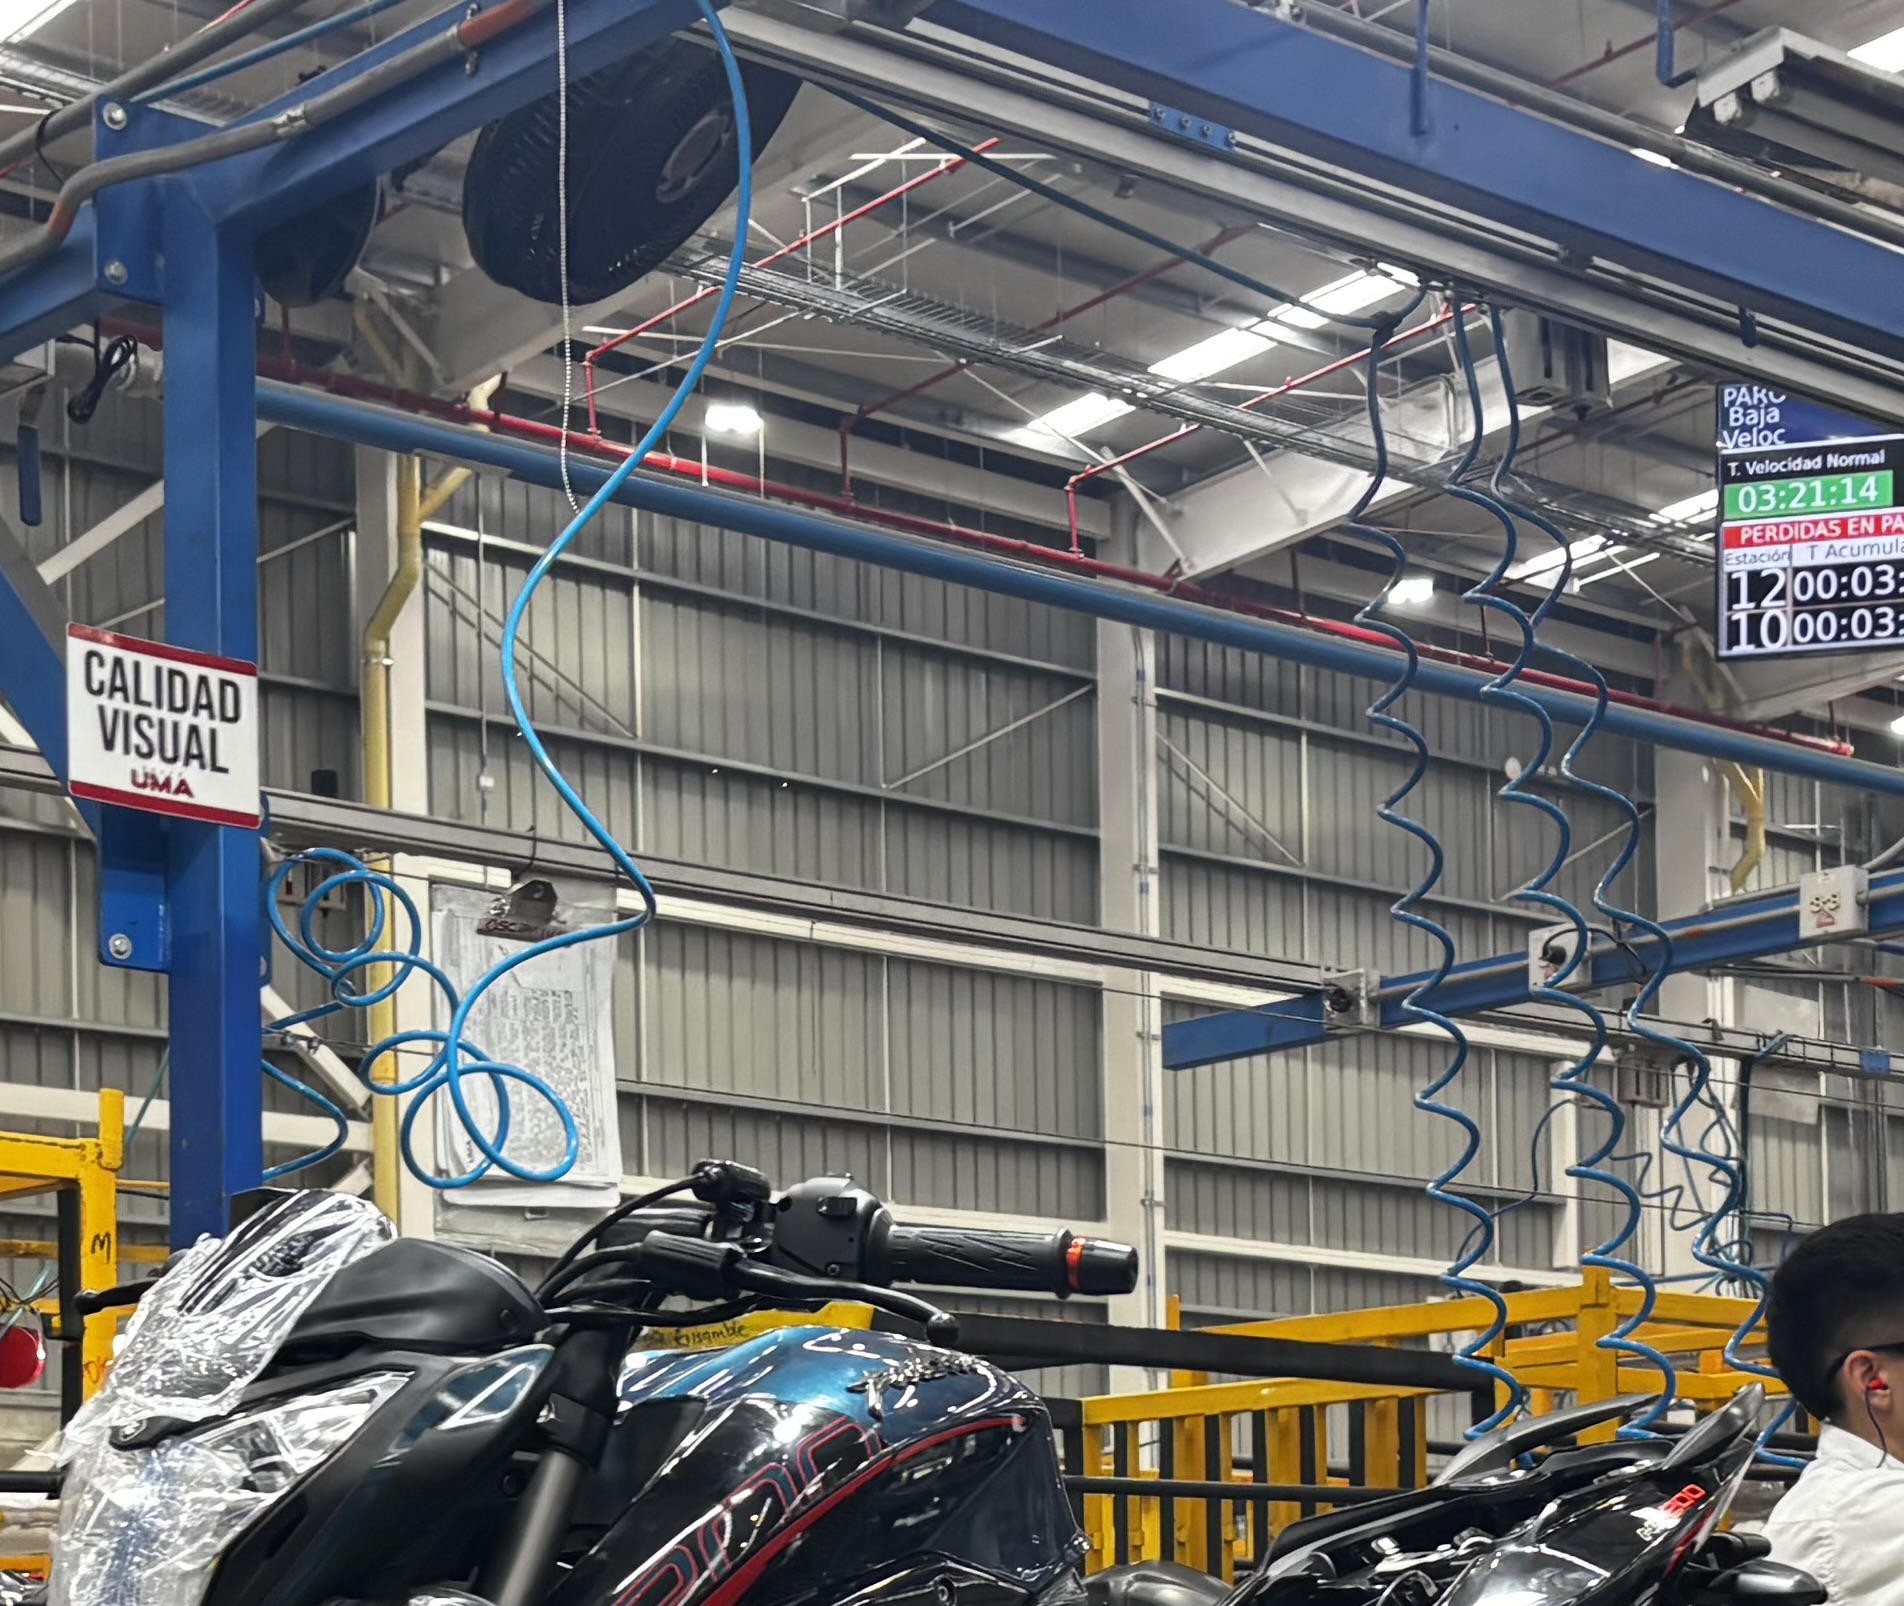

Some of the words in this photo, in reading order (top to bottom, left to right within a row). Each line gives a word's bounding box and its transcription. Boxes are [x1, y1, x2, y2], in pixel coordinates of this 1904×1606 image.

[1729, 403, 1780, 428] Baja
[1722, 428, 1786, 449] Veloc
[1727, 462, 1742, 476] T.
[1745, 455, 1823, 475] Velocidad
[1827, 449, 1886, 467] Normal
[1738, 475, 1879, 513] 03:21:14
[1741, 519, 1842, 545] PERDIDAS
[1847, 516, 1876, 535] EN
[1724, 546, 1789, 566] Estación
[1808, 545, 1820, 561] T
[1731, 567, 1787, 610] 12
[1731, 608, 1788, 650] 10
[84, 650, 241, 724] CALIDAD
[98, 704, 229, 774] VISUAL
[130, 769, 194, 798] UMA
